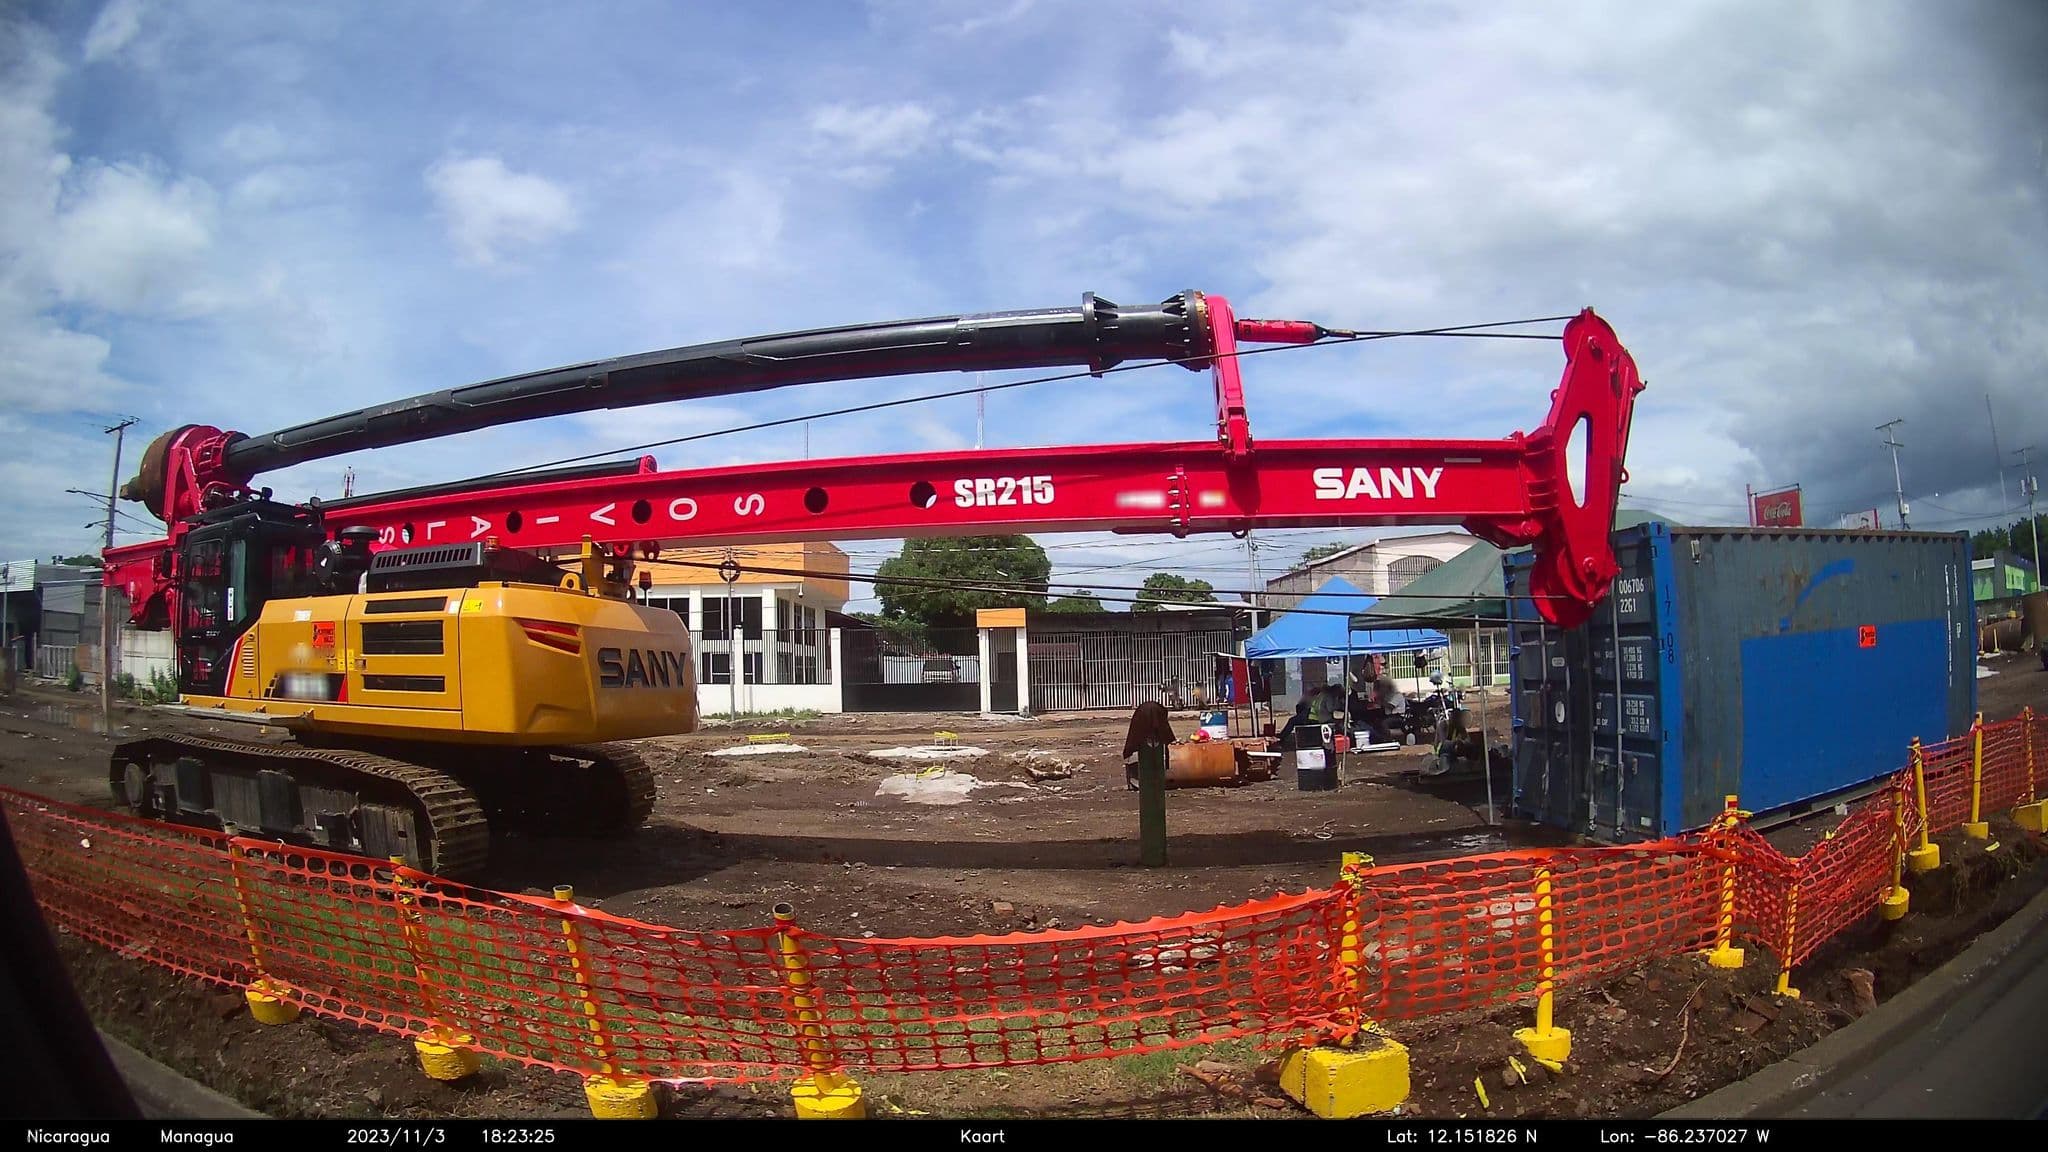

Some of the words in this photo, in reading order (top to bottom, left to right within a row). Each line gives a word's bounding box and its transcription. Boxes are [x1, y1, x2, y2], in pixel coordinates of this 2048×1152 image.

[954, 475, 1055, 507] SR215
[1313, 467, 1444, 500] SANY
[597, 647, 688, 689] SANY
